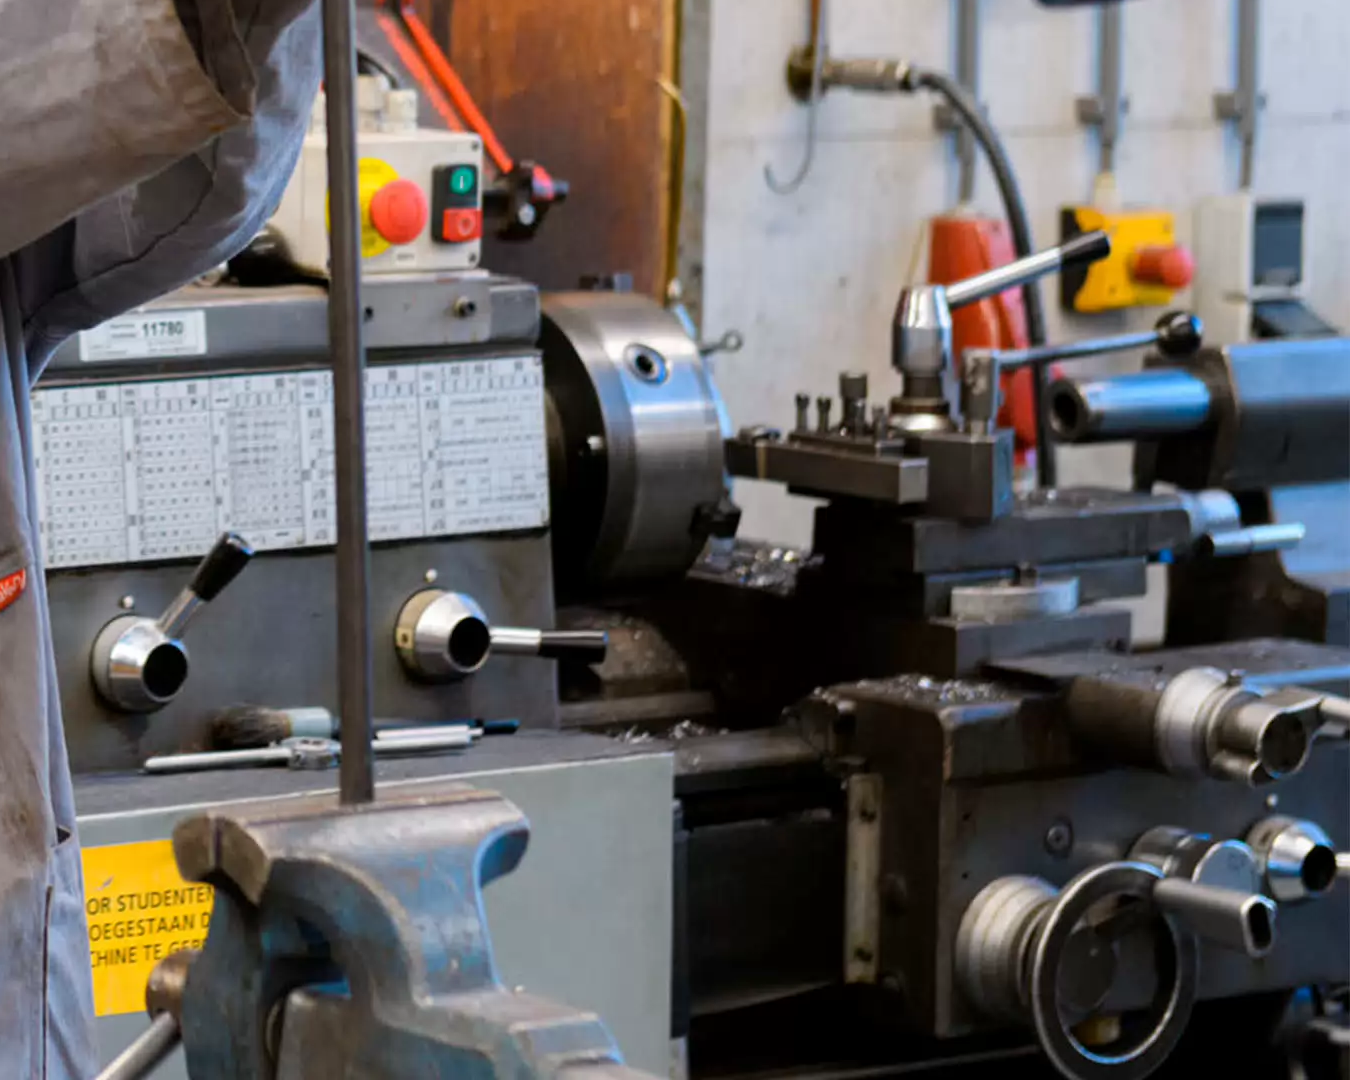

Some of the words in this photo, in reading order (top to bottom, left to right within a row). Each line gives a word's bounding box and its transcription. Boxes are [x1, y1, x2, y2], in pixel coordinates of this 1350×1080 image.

[141, 321, 183, 337] 11780
[86, 897, 111, 915] OR
[89, 914, 195, 941] OEGESTAAN
[143, 943, 162, 961] TE
